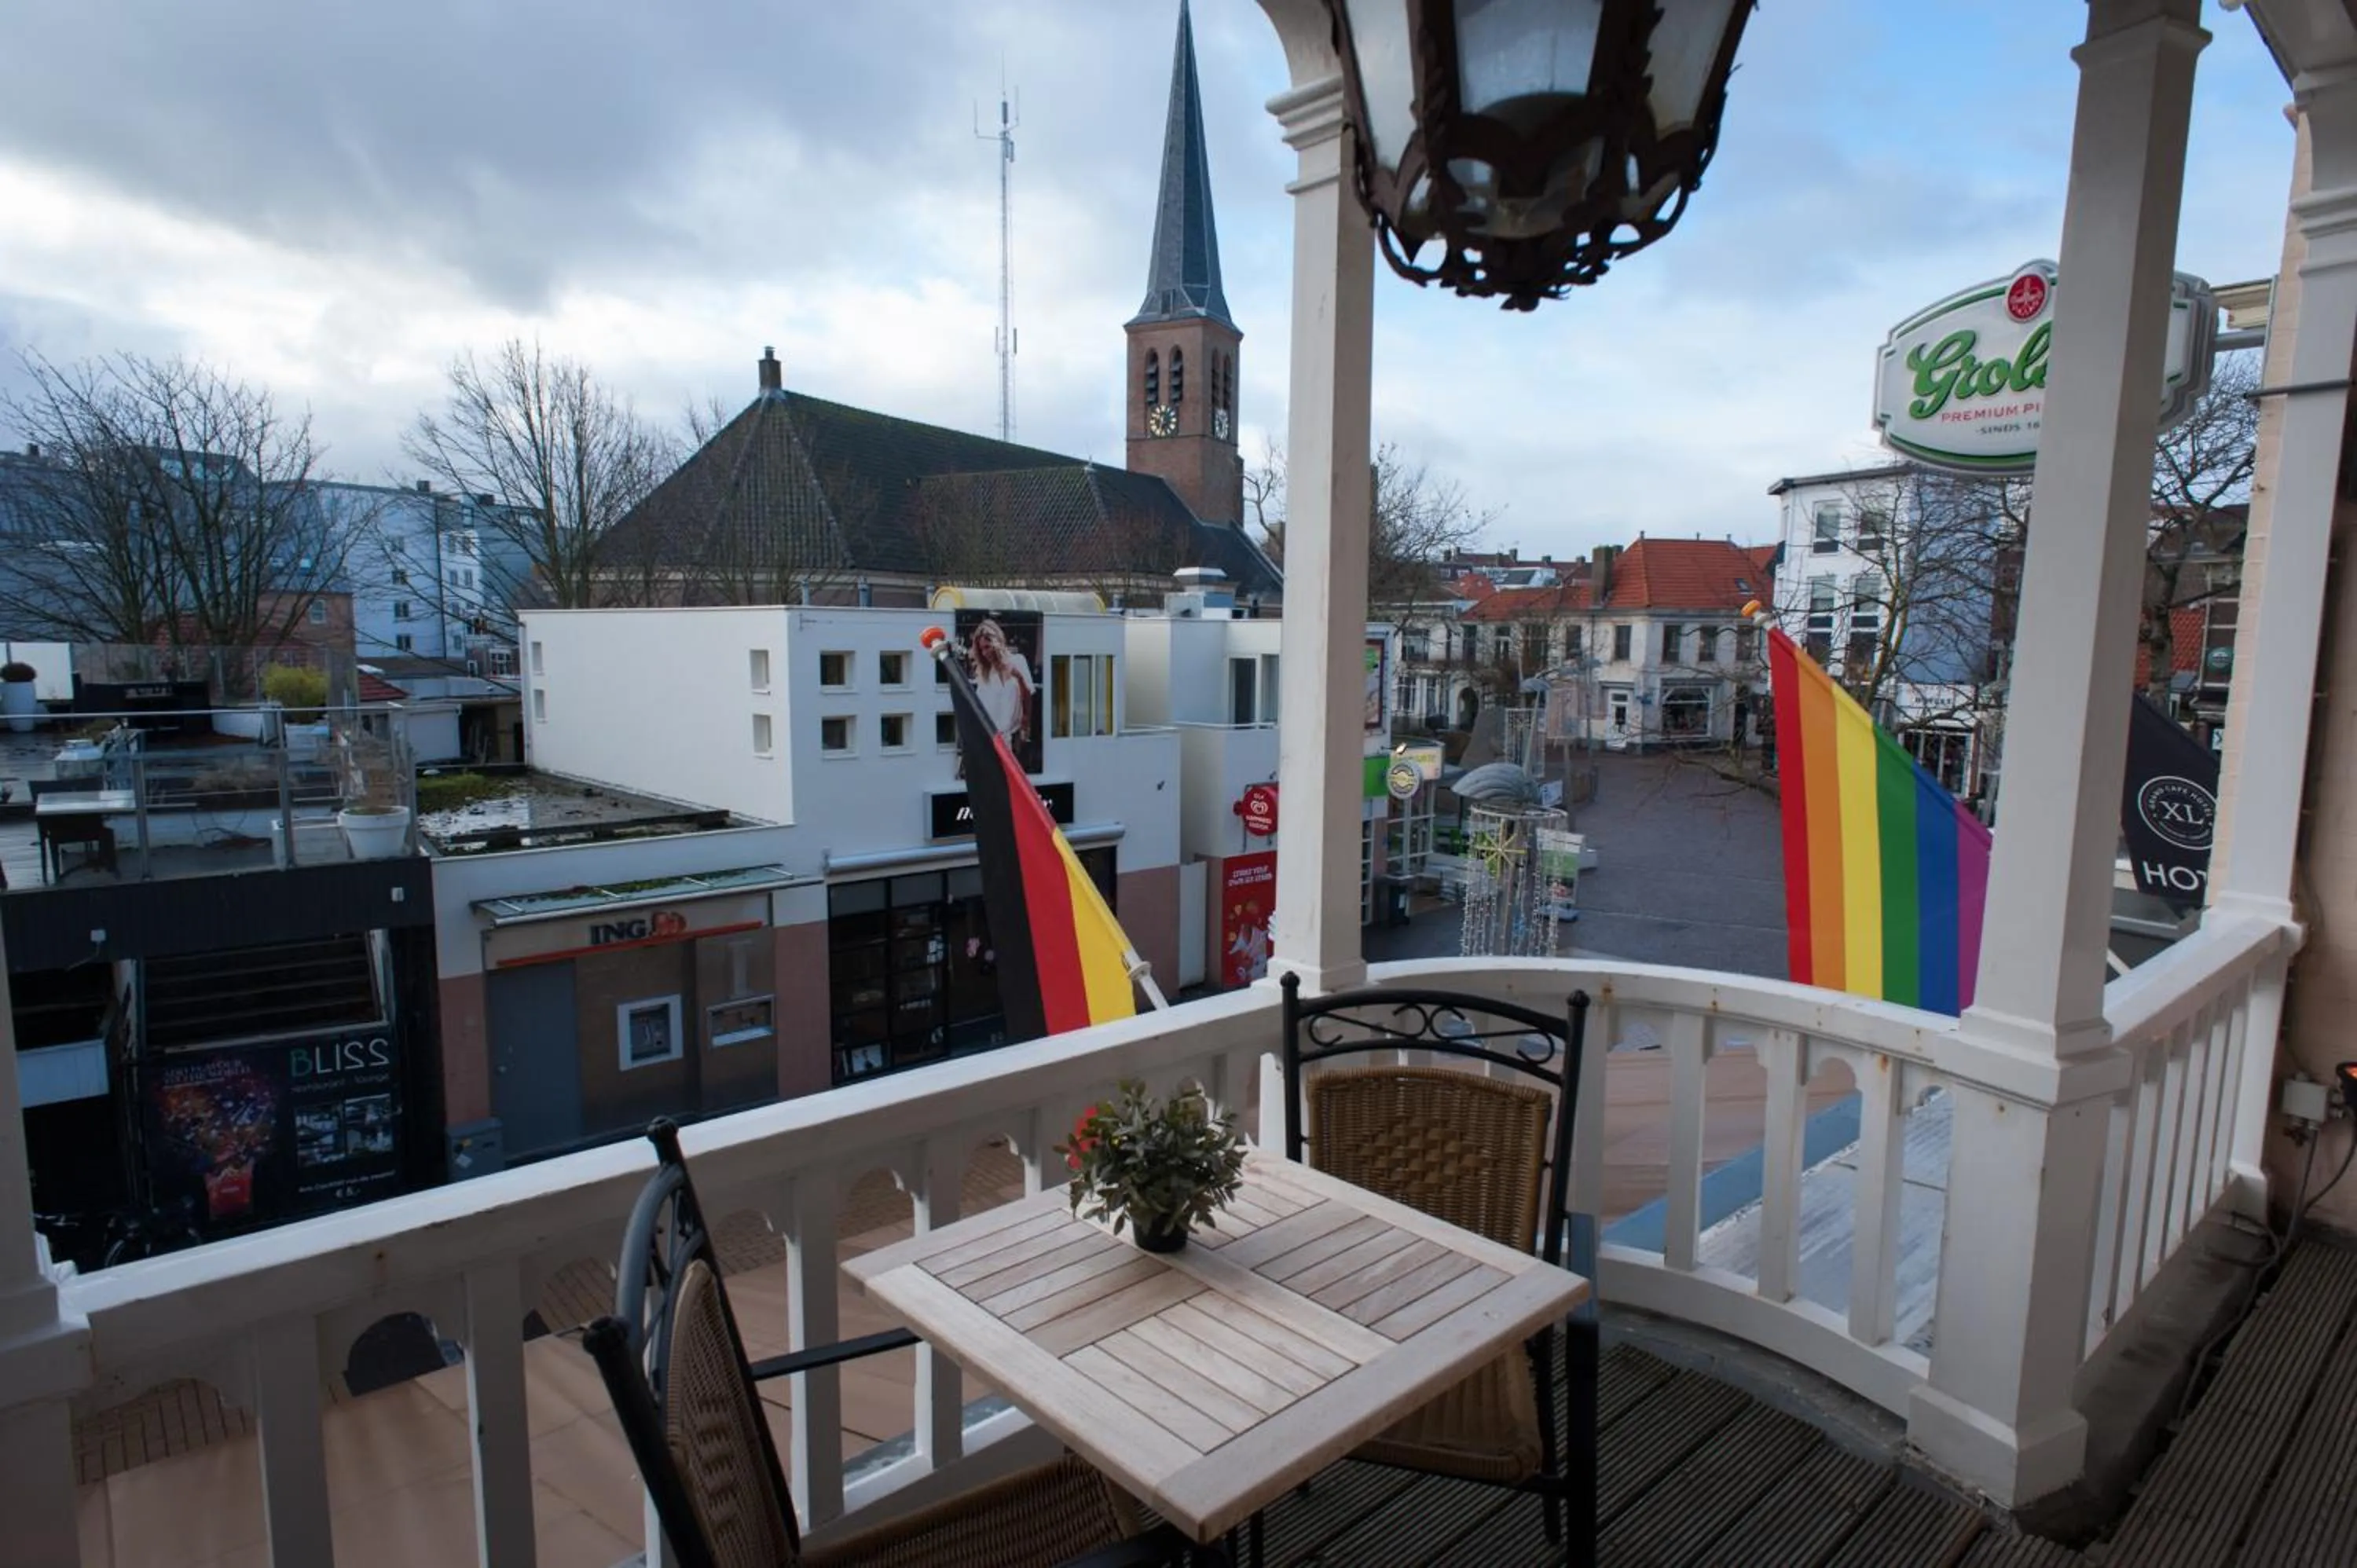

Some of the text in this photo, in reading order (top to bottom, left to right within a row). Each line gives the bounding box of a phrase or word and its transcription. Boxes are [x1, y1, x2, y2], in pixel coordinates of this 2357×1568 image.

[1941, 405, 2018, 423] PREMIUM
[2160, 800, 2205, 825] XL
[590, 918, 647, 944] ING
[290, 1038, 390, 1078] BLISS
